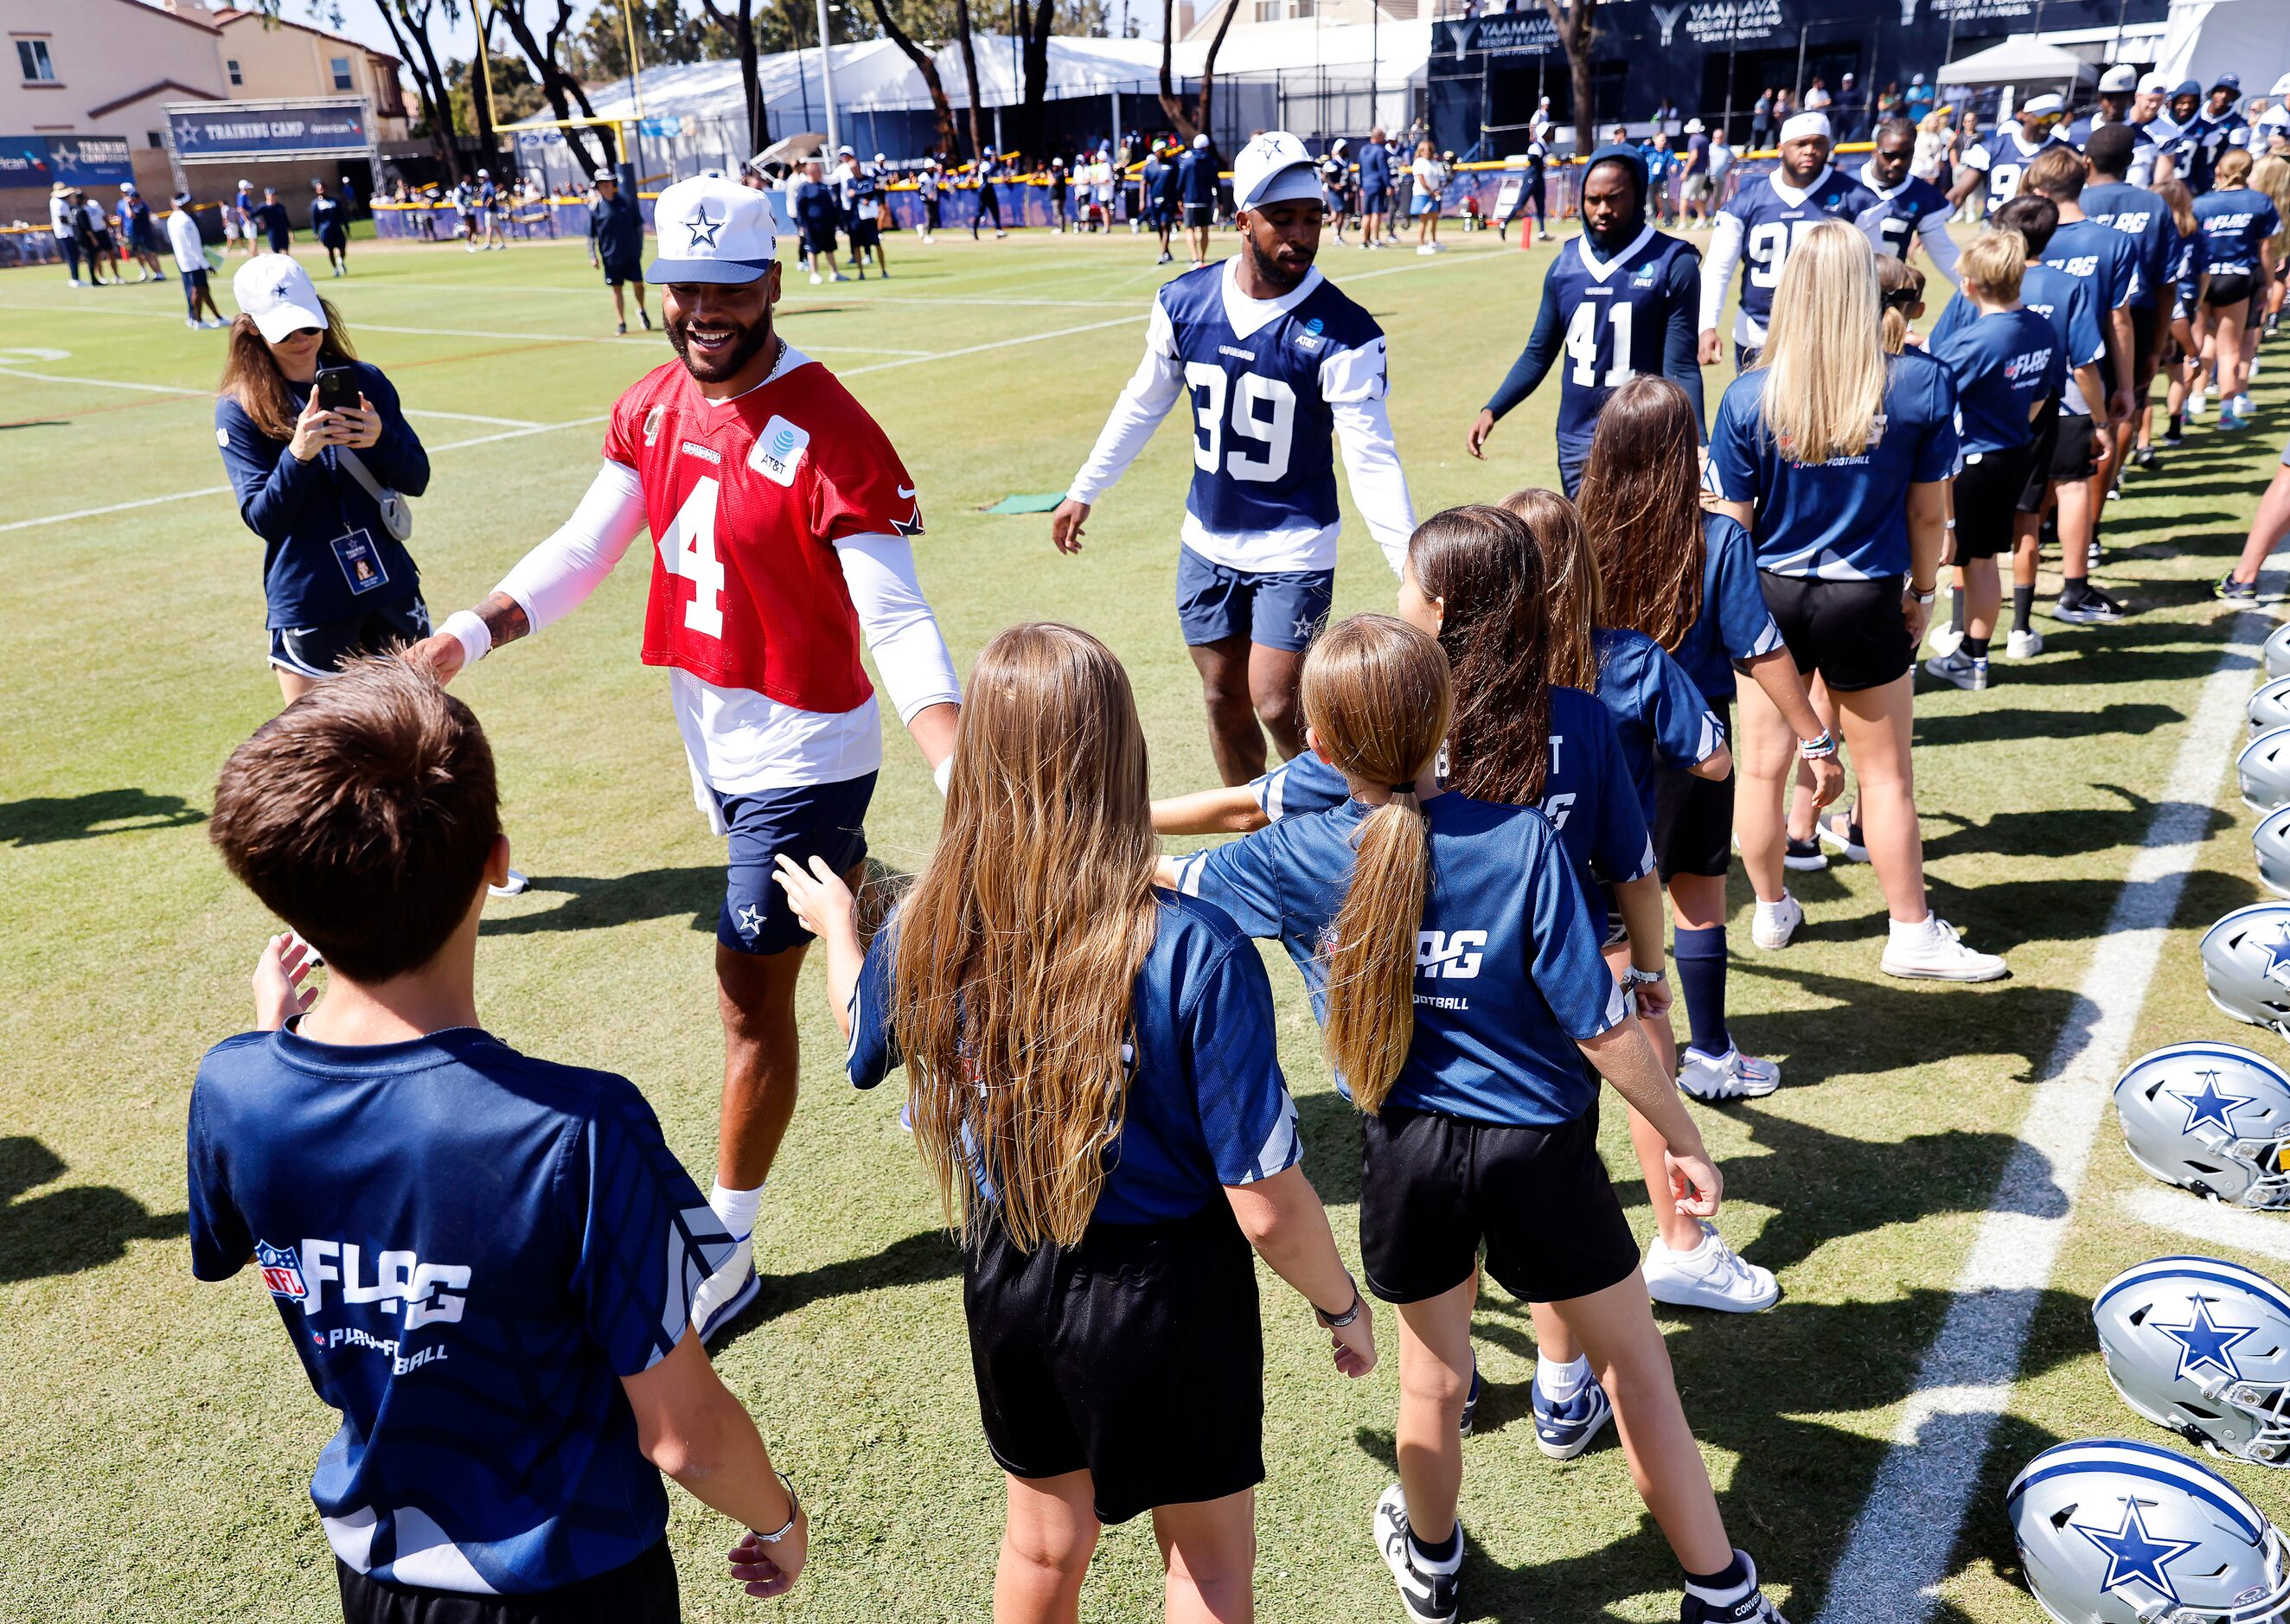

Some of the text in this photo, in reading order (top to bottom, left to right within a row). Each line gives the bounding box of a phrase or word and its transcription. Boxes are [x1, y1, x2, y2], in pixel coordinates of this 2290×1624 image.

[1737, 13, 1782, 28] CASINO
[1977, 3, 2031, 18] MANUEL
[205, 120, 304, 140] TRAINING CAMP
[310, 123, 350, 135] American
[1634, 278, 1654, 288] AT&T
[1295, 335, 1319, 349] AT&T
[1564, 301, 1636, 387] 41
[2012, 347, 2052, 380] FLAG
[1183, 361, 1297, 483] 39
[760, 454, 786, 476] AT&T
[657, 475, 726, 640] 4
[1414, 930, 1488, 979] AG
[1413, 994, 1469, 1010] OOTBALL
[261, 1268, 305, 1298] NFL
[302, 1238, 472, 1331] FLAG
[330, 1327, 375, 1349] PLAY
[2235, 1592, 2267, 1607] OAKLEY
